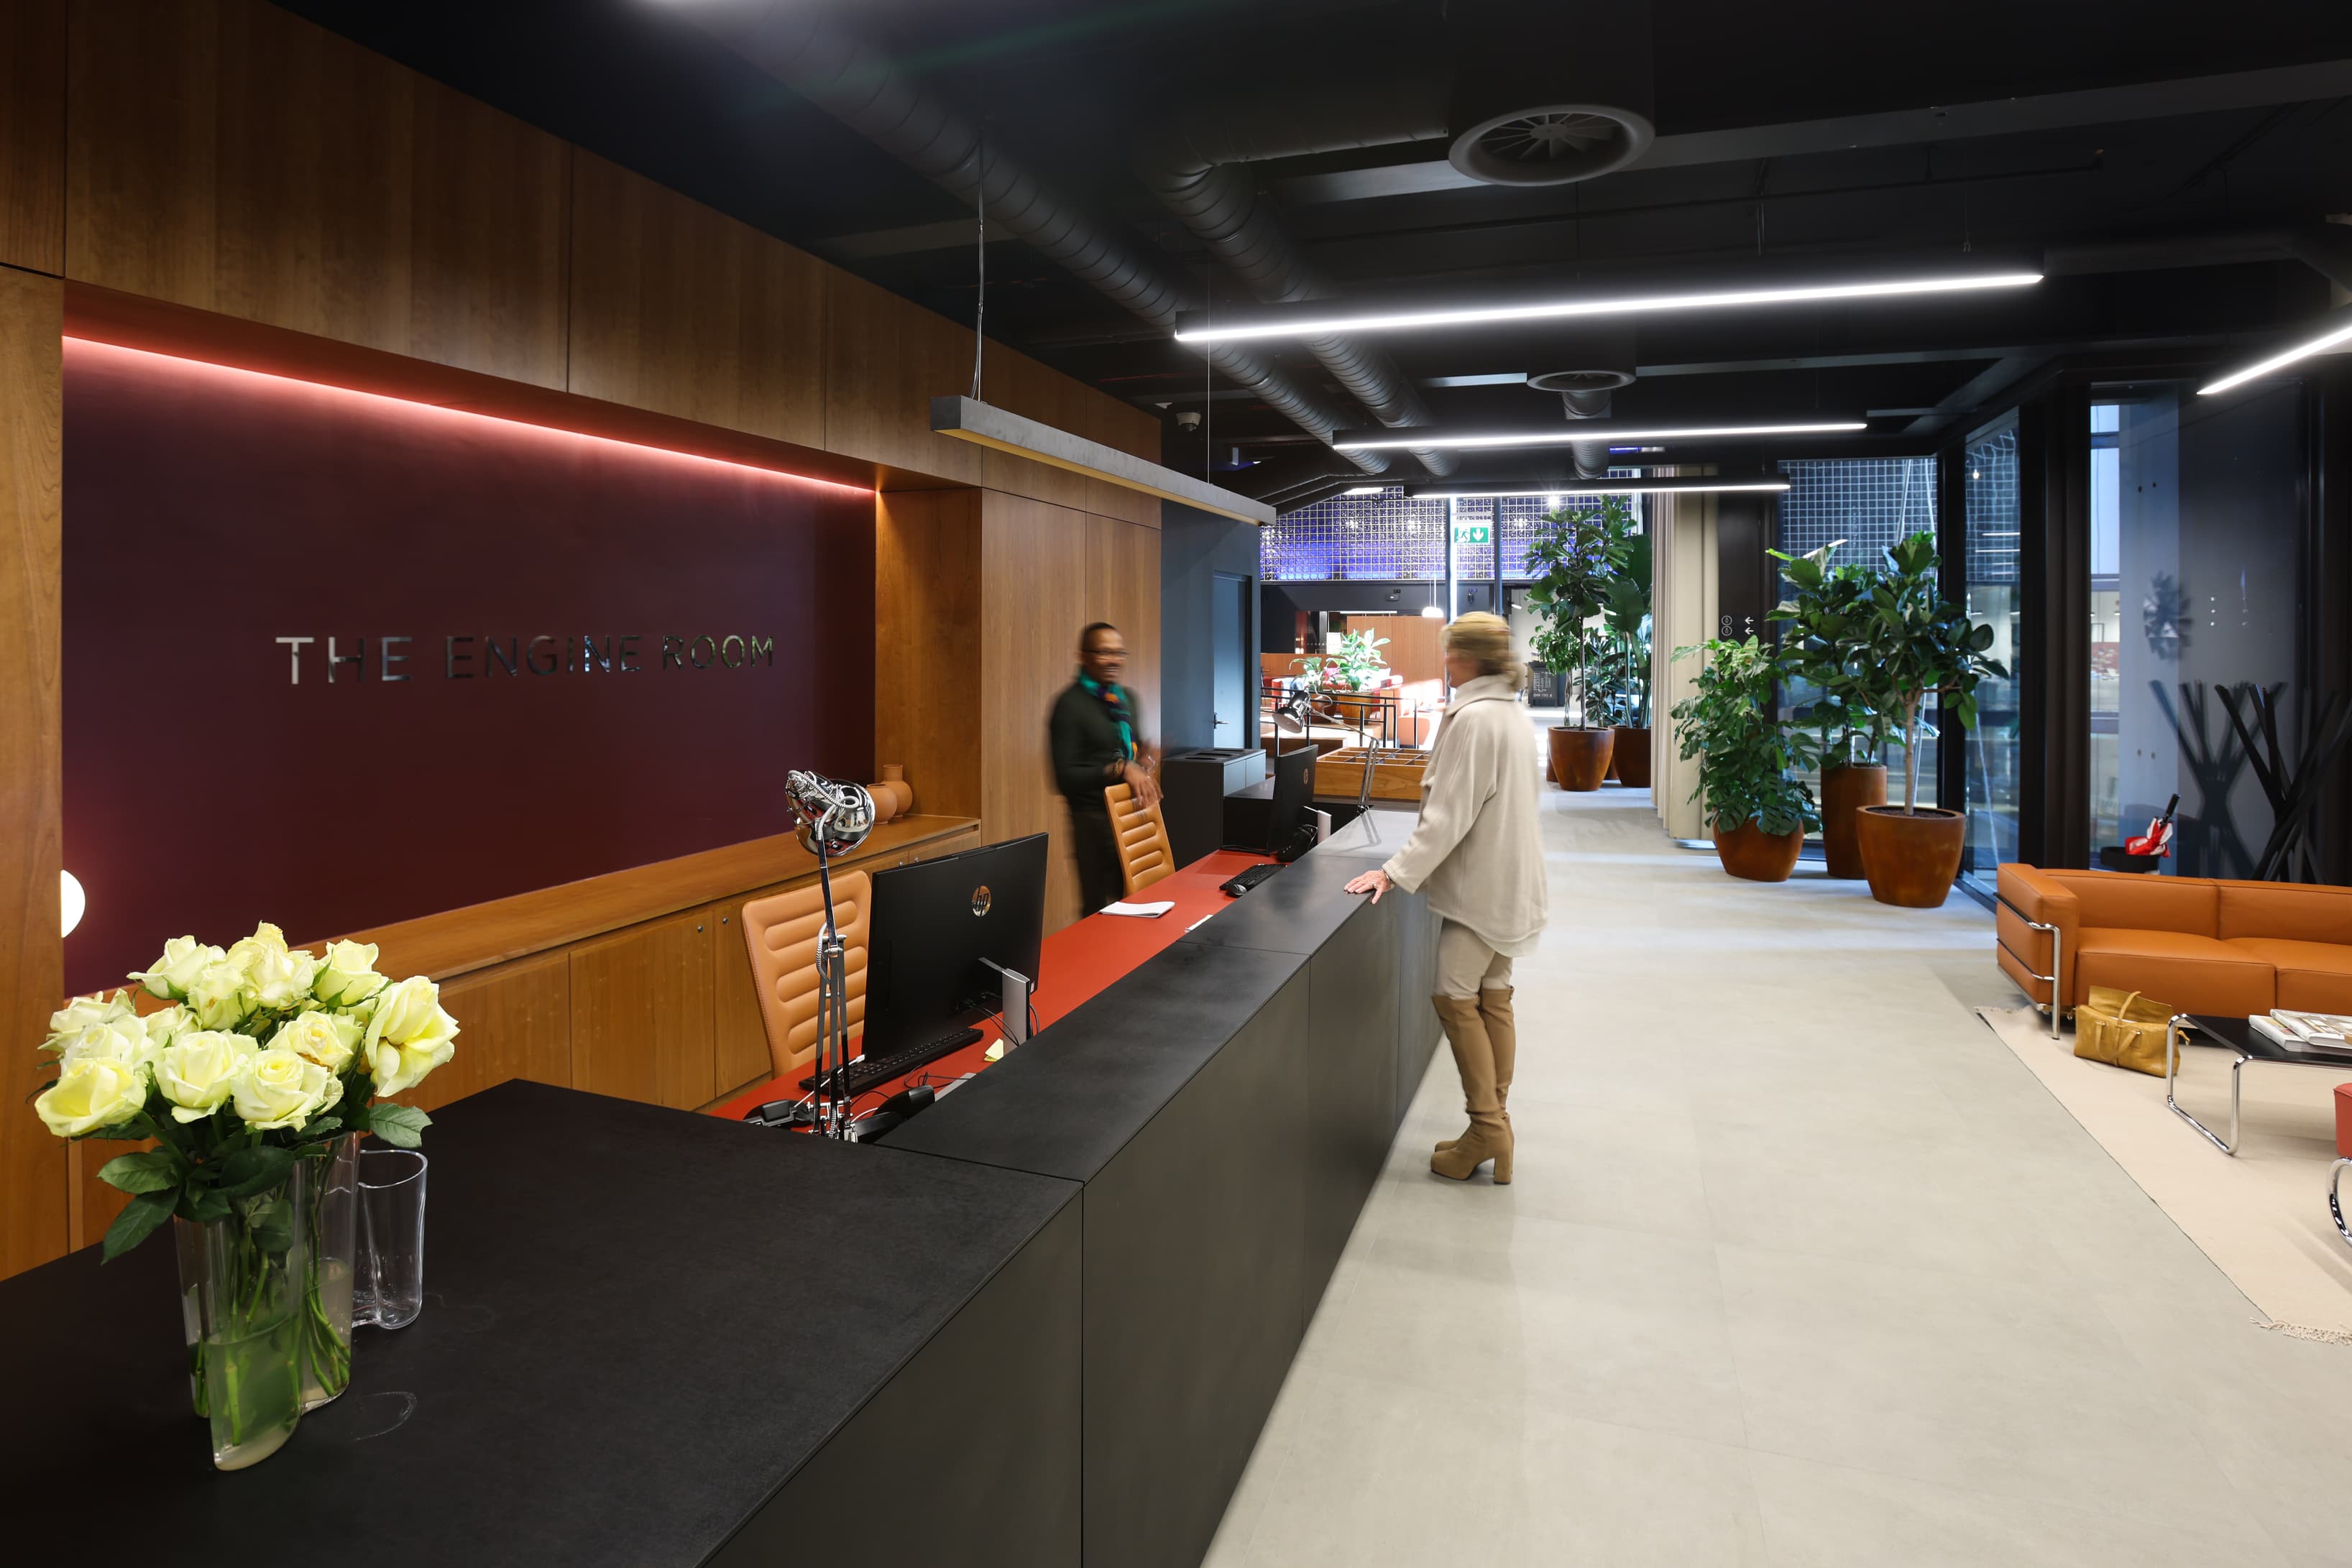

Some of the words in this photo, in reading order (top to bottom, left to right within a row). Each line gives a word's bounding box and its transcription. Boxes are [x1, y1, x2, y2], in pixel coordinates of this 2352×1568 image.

[275, 637, 413, 684] THE
[445, 635, 642, 678] ENGINE
[661, 635, 773, 670] ROOM
[975, 885, 991, 917] hp
